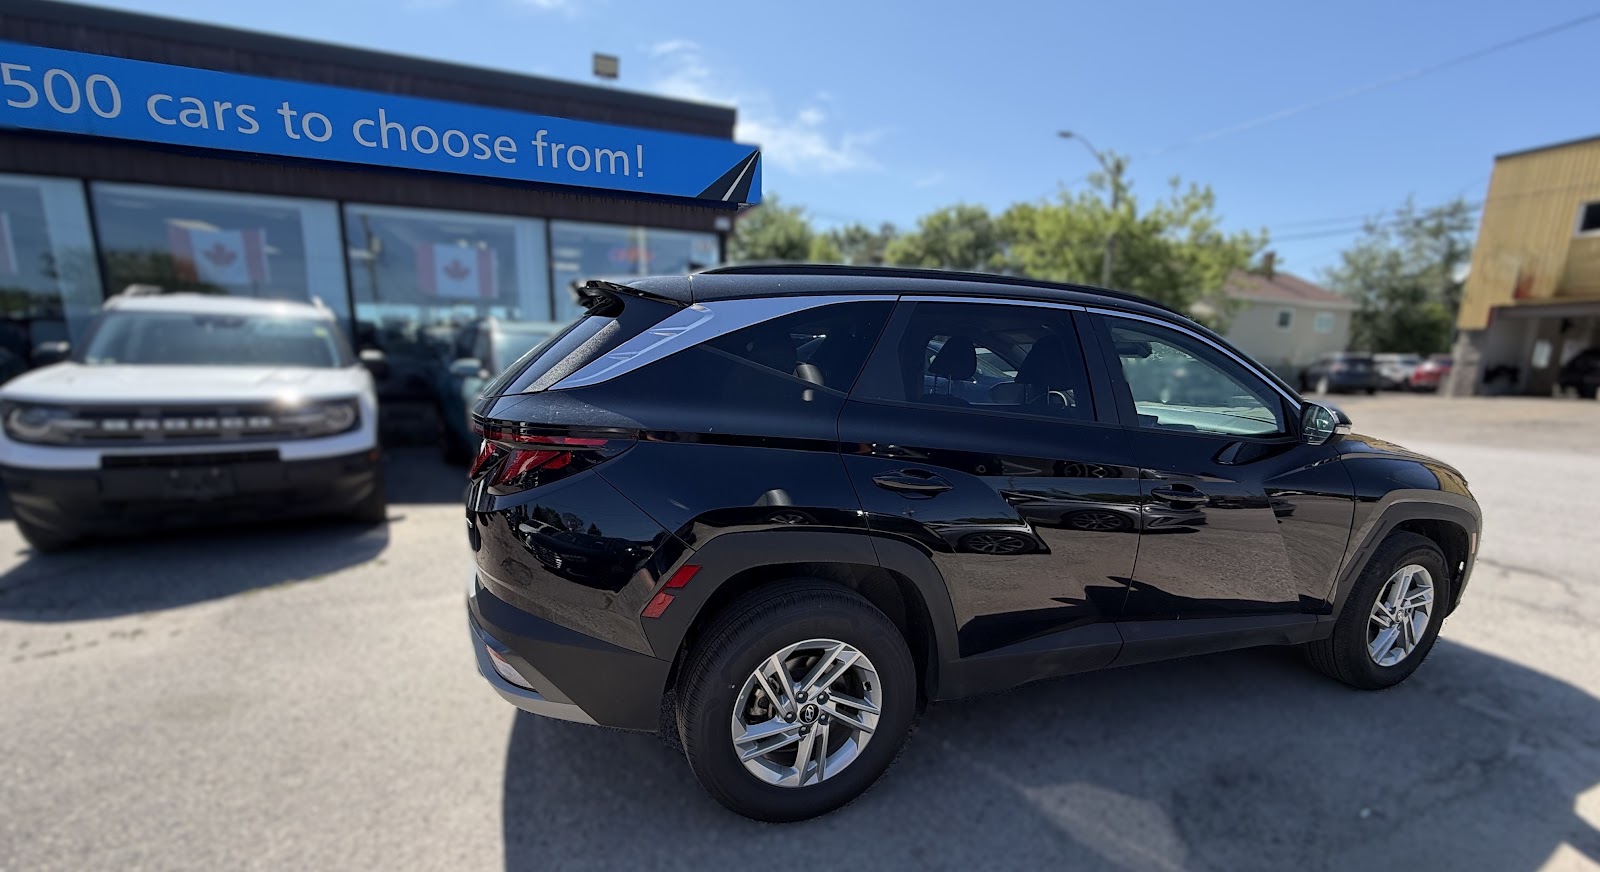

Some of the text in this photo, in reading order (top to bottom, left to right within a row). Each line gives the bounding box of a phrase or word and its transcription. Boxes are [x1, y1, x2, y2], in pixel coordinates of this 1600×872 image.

[0, 62, 644, 178] 500 cars to choose from!
